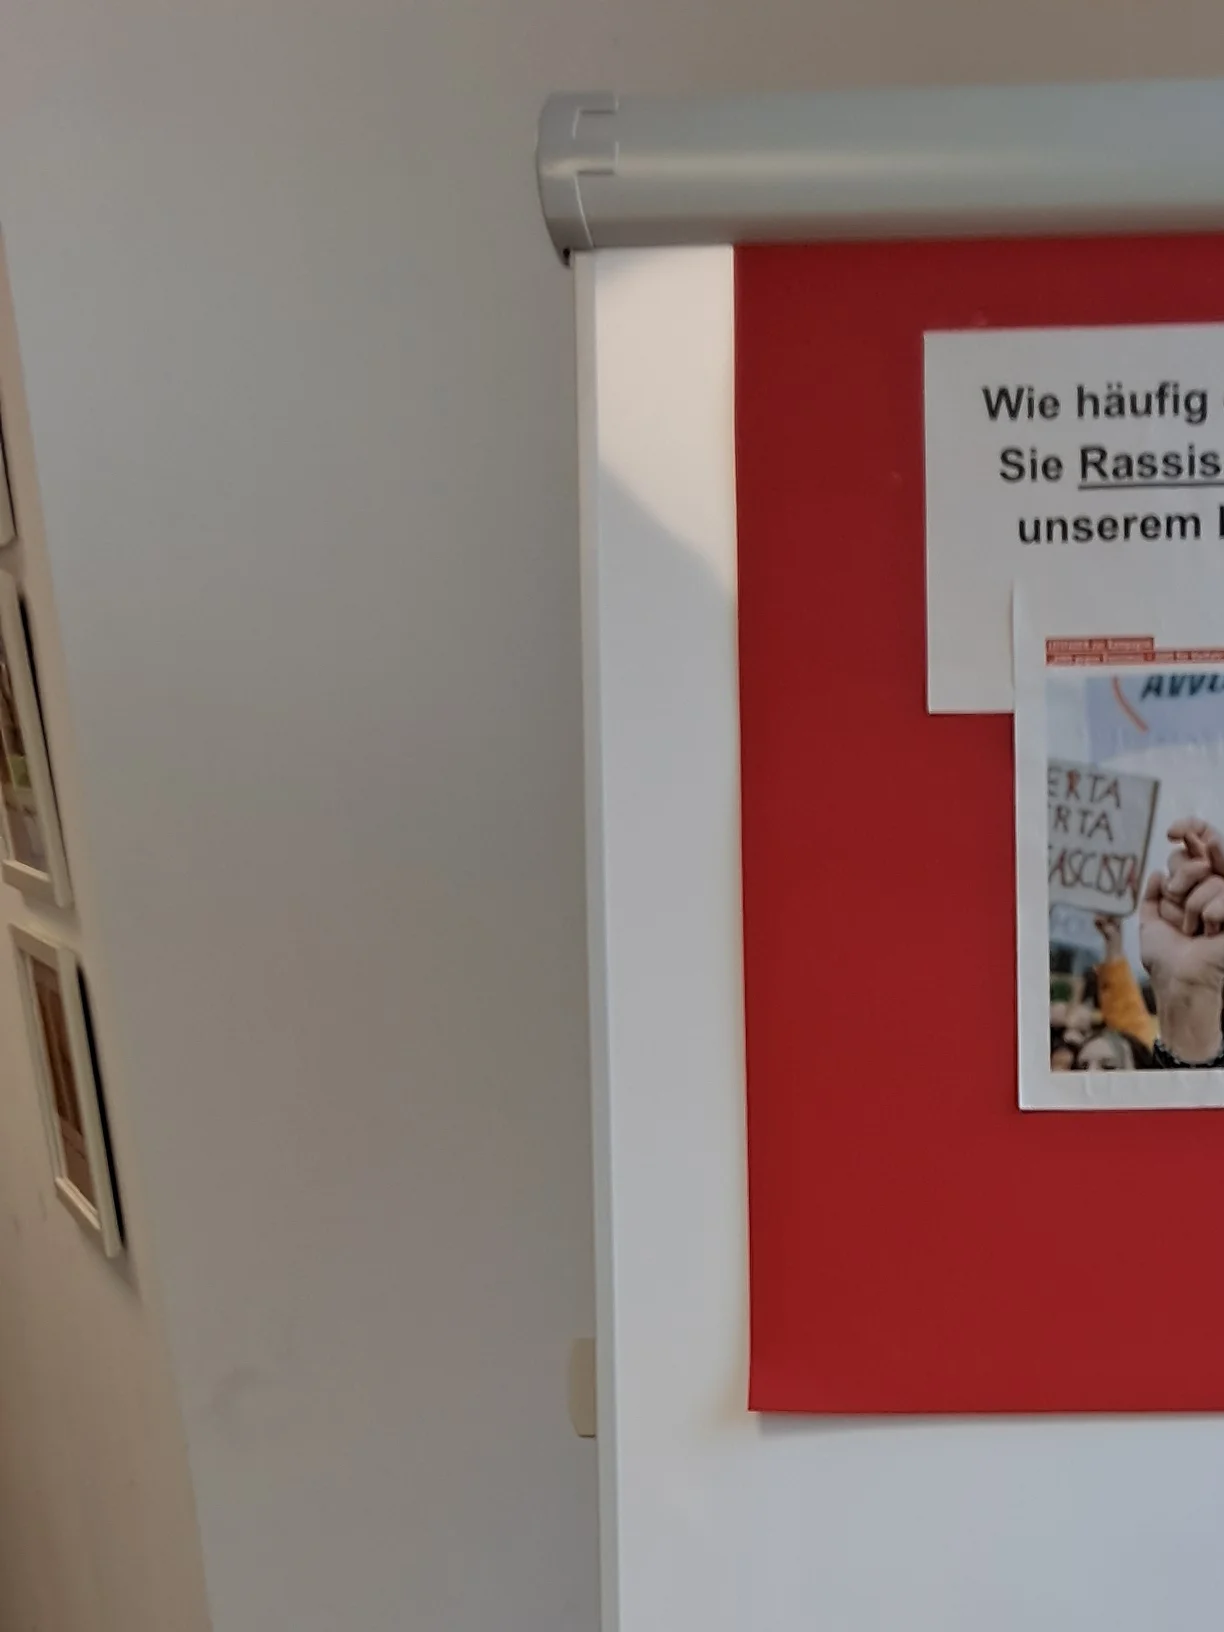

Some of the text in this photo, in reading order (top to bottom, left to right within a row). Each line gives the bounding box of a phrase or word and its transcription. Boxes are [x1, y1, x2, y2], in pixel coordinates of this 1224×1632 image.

[982, 385, 1060, 421] Wie
[1076, 382, 1208, 424] häufig
[999, 446, 1063, 483] Sie
[1018, 507, 1200, 544] unserem
